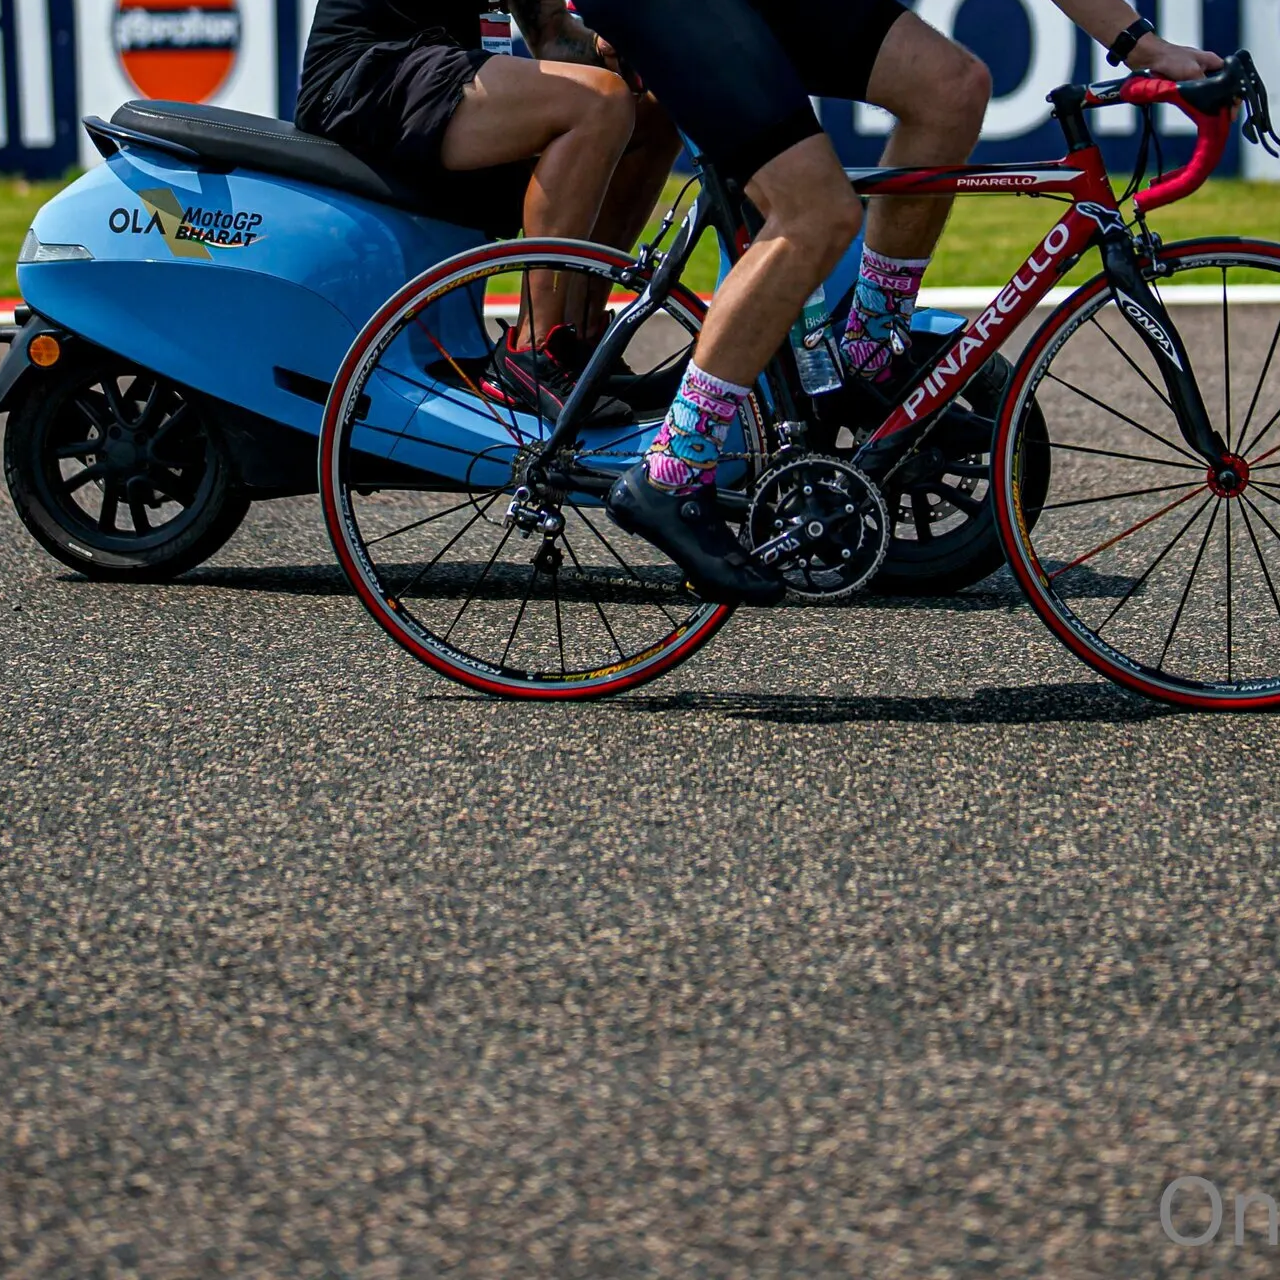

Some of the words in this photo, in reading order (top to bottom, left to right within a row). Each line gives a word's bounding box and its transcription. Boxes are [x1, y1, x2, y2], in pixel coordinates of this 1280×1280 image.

[957, 177, 1033, 187] PINARELLO
[109, 208, 167, 235] OLA
[180, 207, 263, 231] MotoGP
[175, 226, 258, 247] BHARAT
[861, 266, 910, 290] VANS
[902, 222, 1069, 421] PINARELLO
[1125, 305, 1170, 349] ONDA
[682, 385, 734, 415] VANS
